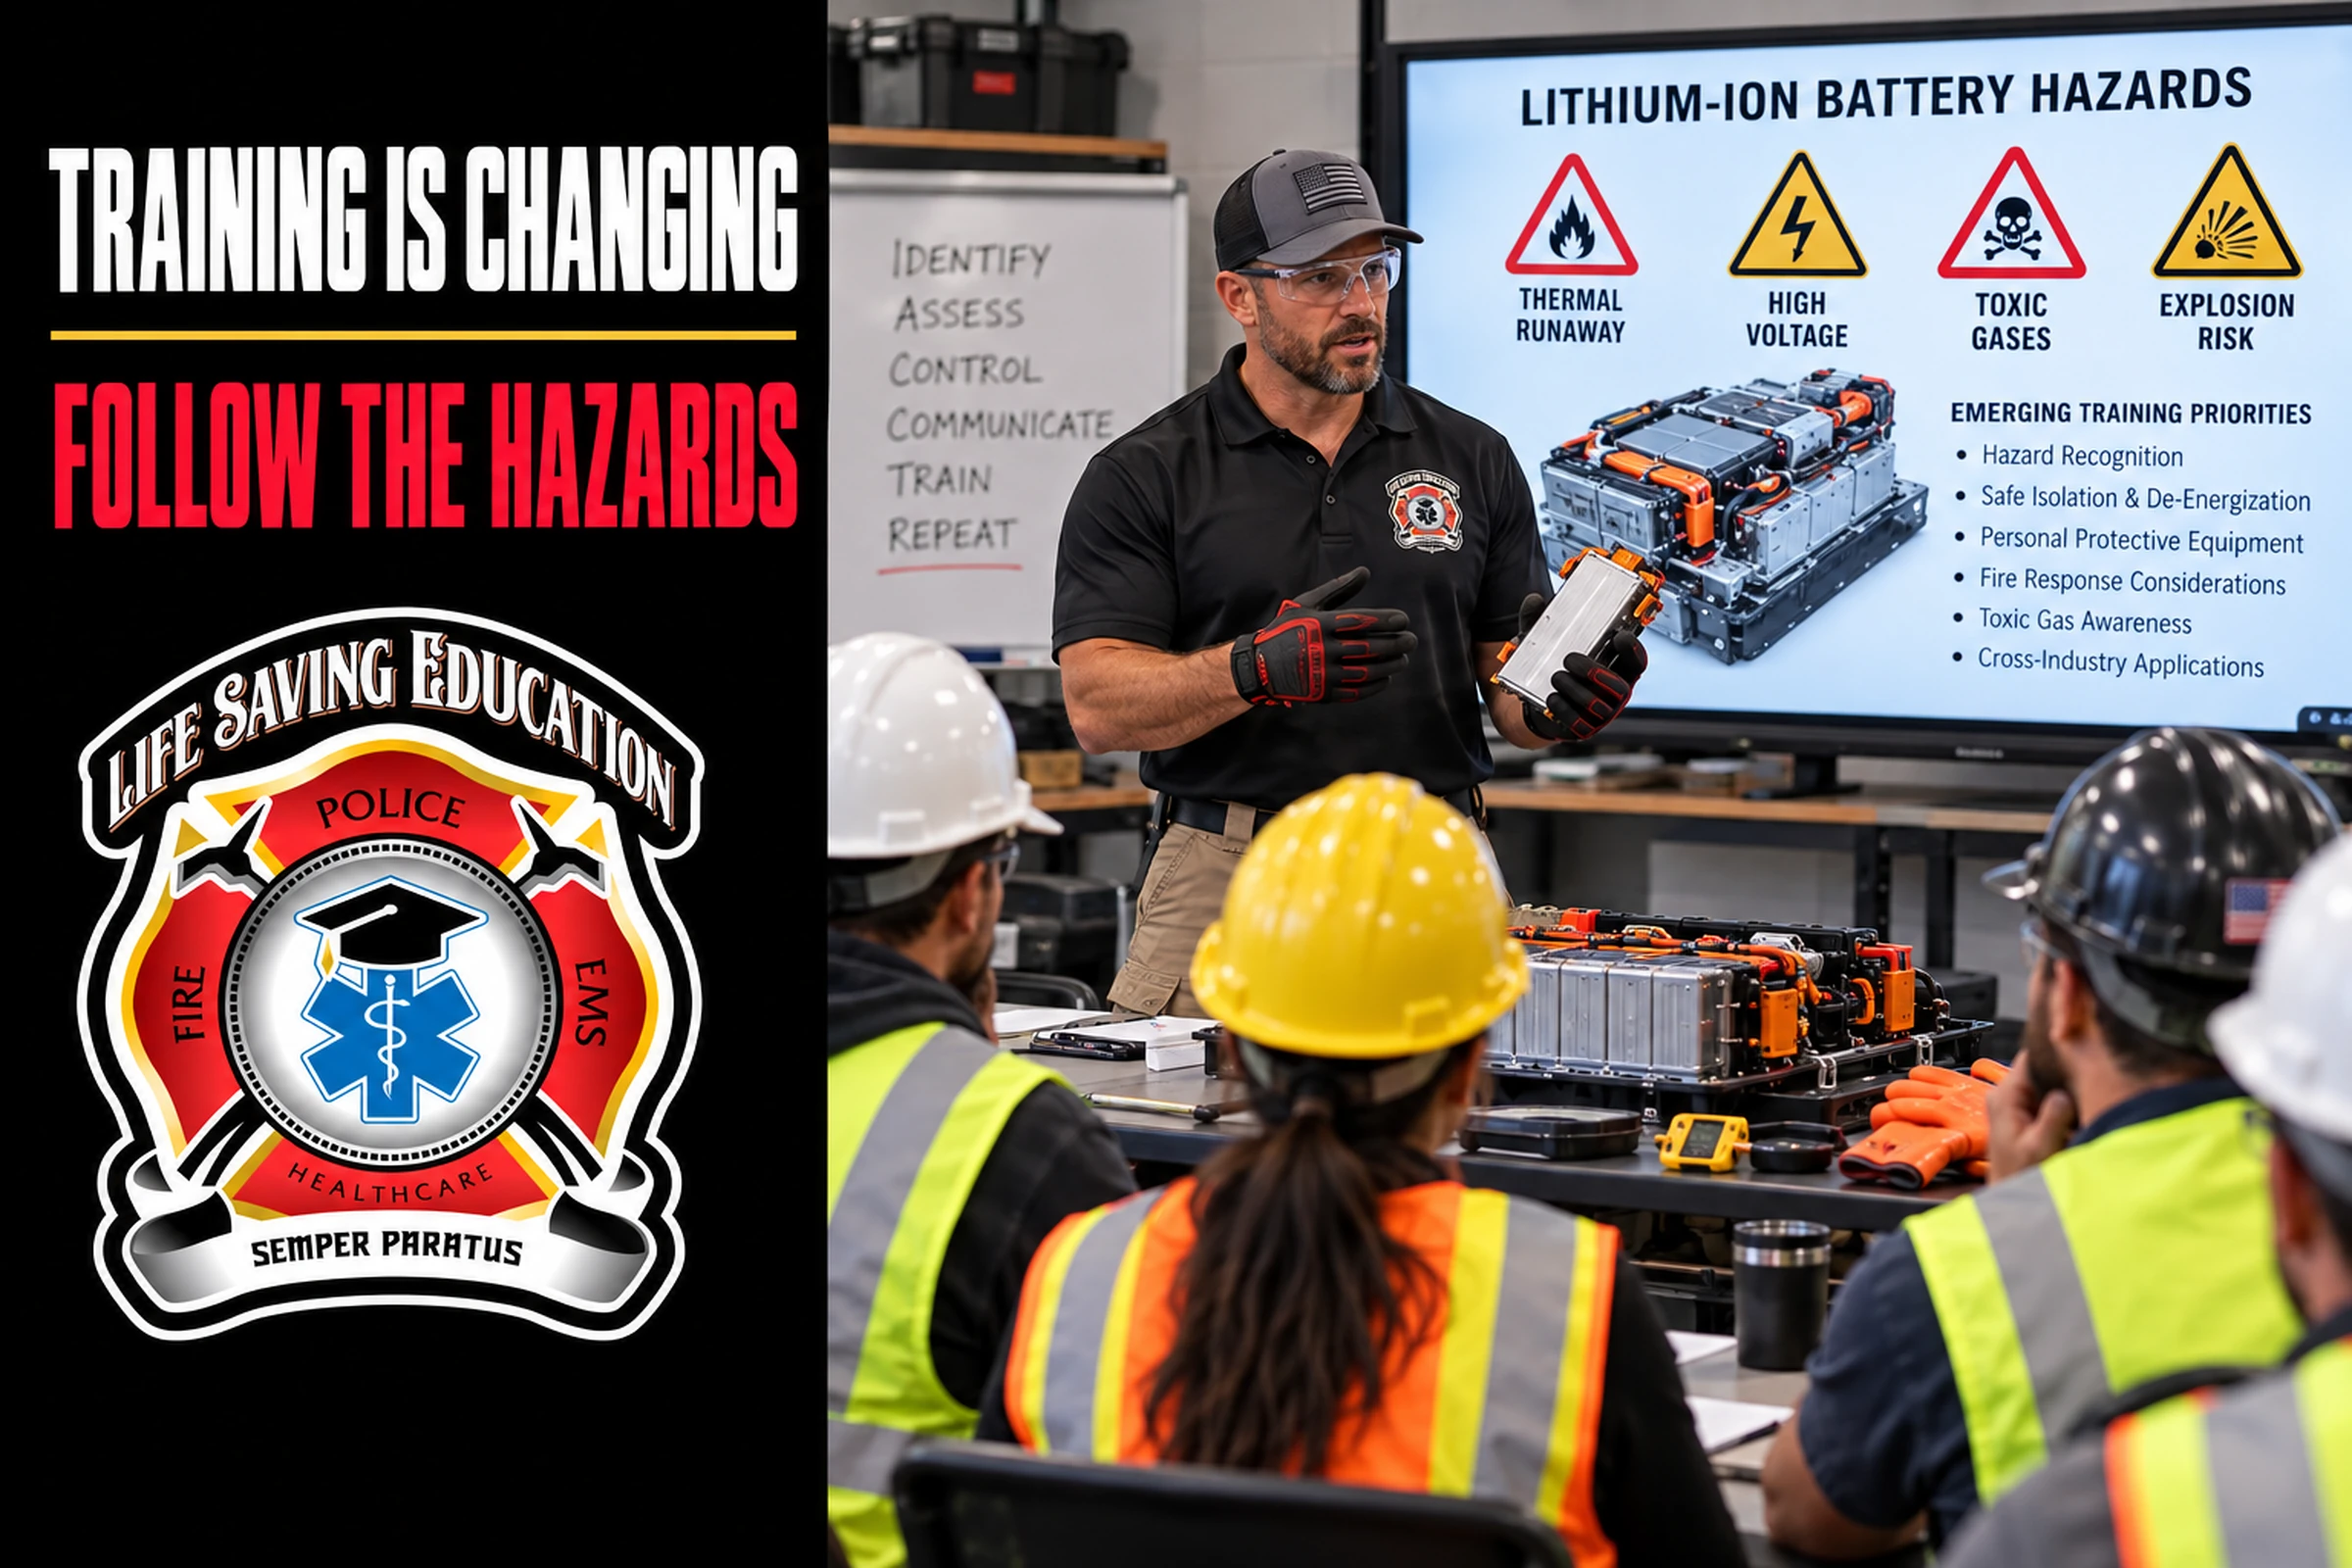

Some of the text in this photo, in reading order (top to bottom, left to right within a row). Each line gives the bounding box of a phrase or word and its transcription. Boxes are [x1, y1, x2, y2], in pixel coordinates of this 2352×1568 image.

[1522, 66, 2252, 126] LITHIUM-ION BATTERY HAZARDS
[892, 237, 1053, 280] IDENTIFY
[893, 295, 1025, 333] ASSESS
[1519, 287, 1623, 312] THERMAL
[1769, 291, 1826, 316] HIGH
[1975, 292, 2047, 318] TOXIC
[2160, 293, 2294, 318] EXPLOSION
[1516, 318, 1626, 344] RUNAWAY
[1746, 322, 1848, 348] VOLTAGE
[1972, 325, 2051, 351] GASES
[2198, 326, 2254, 351] RISK
[888, 351, 1044, 388] CONTROL
[886, 408, 1114, 442] COMMUNICATE
[1951, 402, 2312, 425] EMERGING TRAINING PRIORITIES
[1984, 444, 2183, 472] Hazard Recognition
[886, 461, 992, 497] TRAIN
[1982, 484, 2311, 516] Safe Isolation & De-Energization
[888, 516, 1018, 553] REPEAT
[1982, 525, 2304, 559] Personal Protective Equipment
[1981, 566, 2286, 596] Fire Response Considerations
[1979, 607, 2192, 635] Toxic Gas Awareness
[1978, 647, 2265, 680] Cross-Industry Applications
